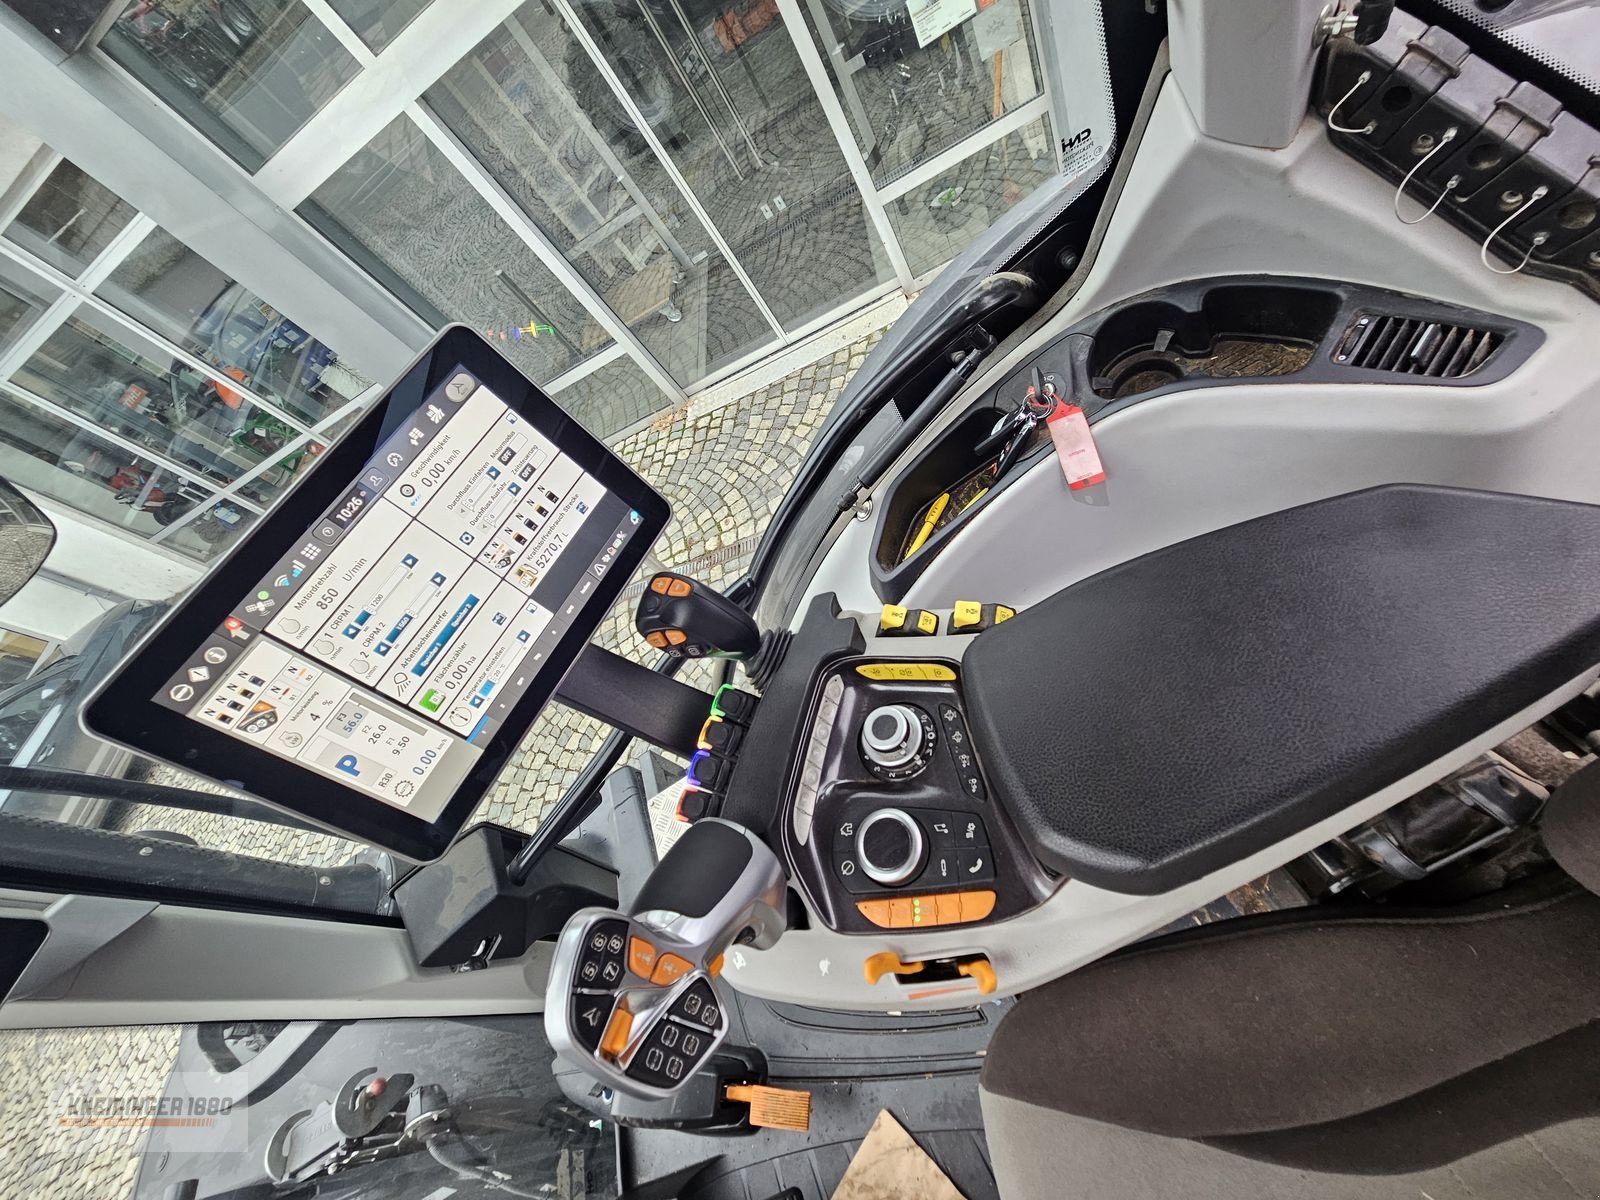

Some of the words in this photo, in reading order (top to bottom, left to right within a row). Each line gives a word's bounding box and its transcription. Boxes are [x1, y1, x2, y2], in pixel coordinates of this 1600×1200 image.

[489, 429, 516, 459] Motormodus
[409, 433, 452, 479] Geschwindigkeit
[500, 449, 513, 462] OFF
[510, 443, 538, 476] Zeitsteuerung
[419, 461, 448, 489] 0,00
[442, 447, 461, 466] km/h
[520, 465, 533, 478] OFF
[446, 482, 471, 510] Durchfluss
[467, 460, 490, 485] Einfahren
[536, 484, 545, 492] N
[334, 495, 363, 523] 10:26
[469, 498, 493, 526] Durchfluss
[525, 498, 535, 506] N
[514, 512, 524, 520] N
[526, 510, 566, 562] Kraftstoffverbrauch
[562, 492, 579, 513] Strecke
[503, 526, 513, 535] N
[490, 540, 499, 548] N
[534, 533, 566, 570] 5270,7
[292, 562, 338, 611] Motordrehzahl
[314, 586, 340, 610] 850
[340, 555, 368, 583] U/min
[369, 593, 384, 608] 1200
[329, 608, 350, 630] CRPM
[361, 626, 382, 648] CRPM
[399, 608, 449, 669] Arbeitsscheinwerfer
[358, 650, 370, 658] 2
[432, 640, 468, 683] Flächenzähler
[236, 669, 249, 679] N
[286, 665, 298, 674] N
[443, 662, 471, 692] 0,00
[465, 654, 477, 666] ha
[461, 670, 488, 703] Temperatur
[483, 645, 506, 672] einstellen
[225, 682, 239, 691] N
[269, 684, 282, 694] N
[214, 694, 228, 704] N
[289, 690, 320, 722] Motorleistung
[306, 712, 321, 722] 4
[321, 697, 334, 707] %
[203, 707, 217, 717] N
[335, 711, 347, 722] F3
[342, 711, 364, 733] 56.0
[361, 724, 372, 734] F2
[366, 723, 388, 744] 26.0
[385, 736, 395, 745] F1
[390, 734, 411, 756] 9.50
[334, 753, 361, 777] P
[410, 747, 438, 776] 0.00
[435, 737, 448, 750] km/h
[377, 772, 394, 787] R30
